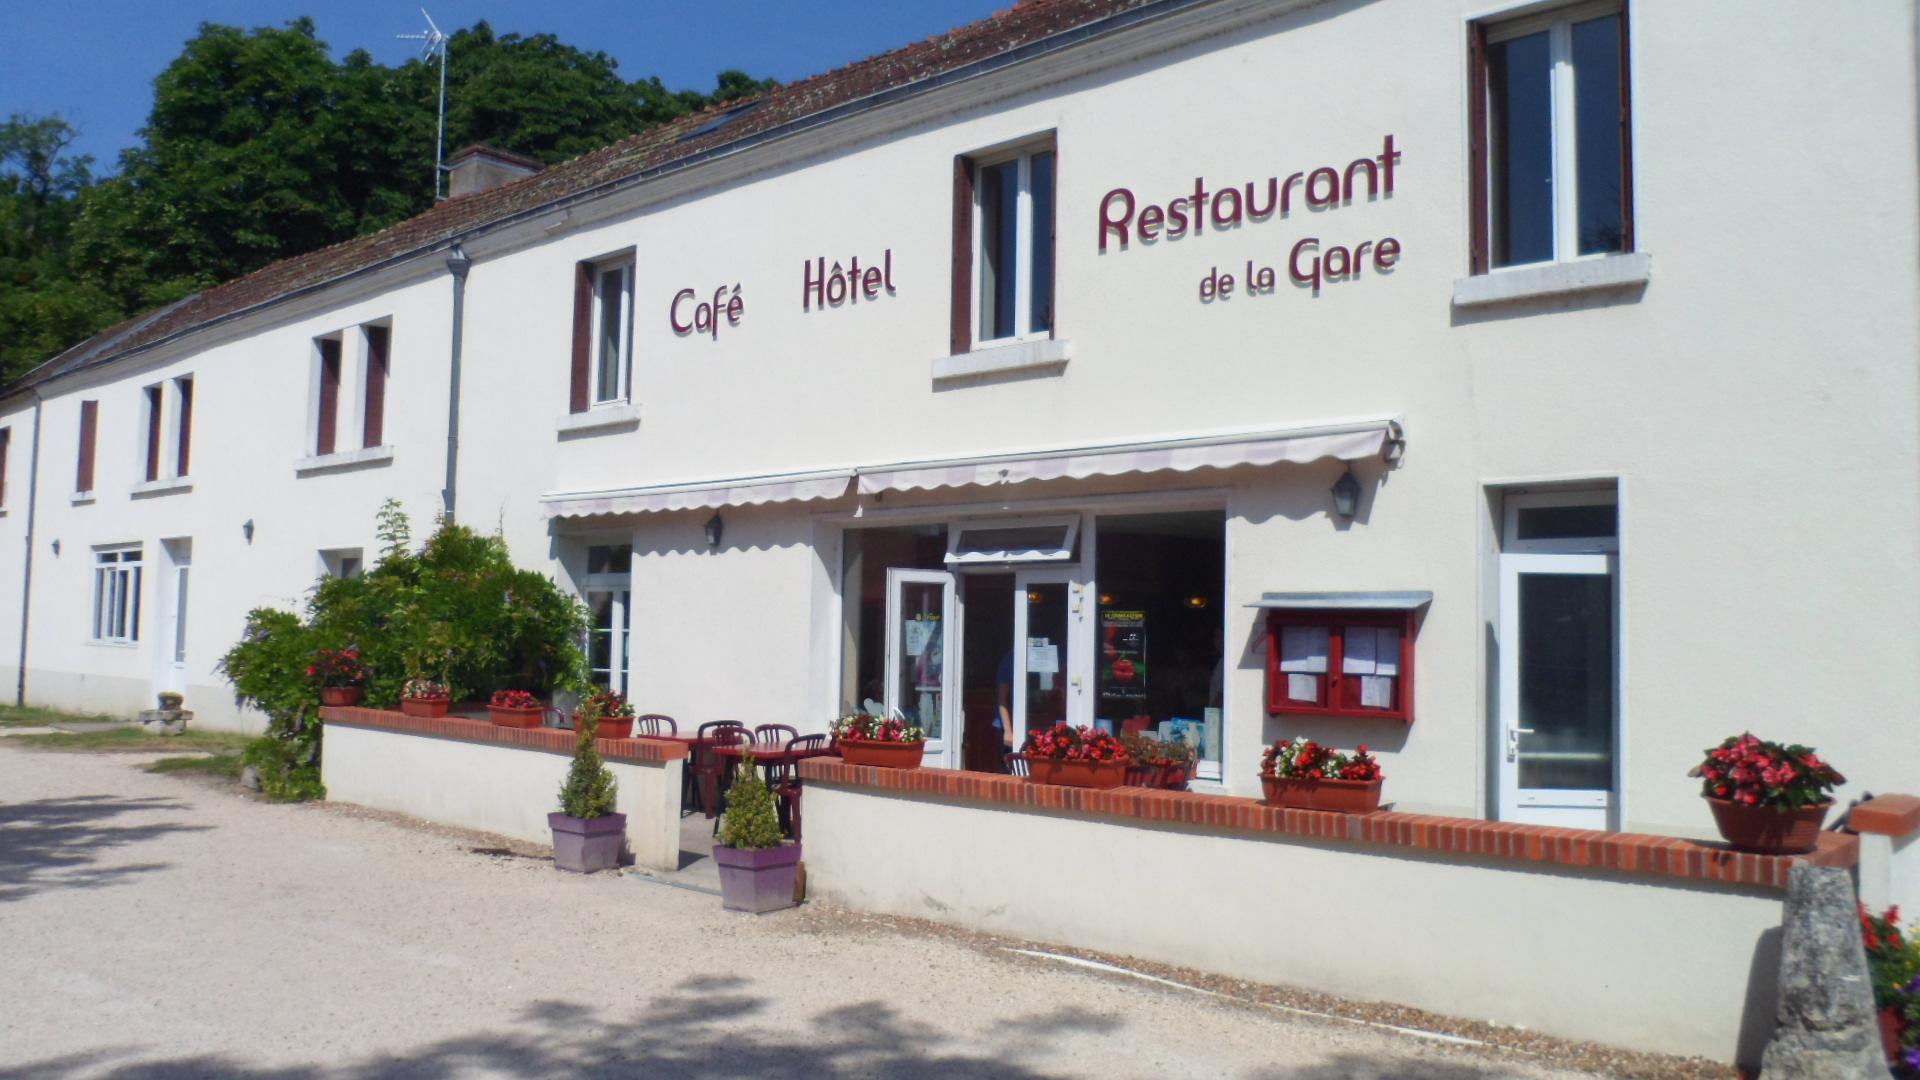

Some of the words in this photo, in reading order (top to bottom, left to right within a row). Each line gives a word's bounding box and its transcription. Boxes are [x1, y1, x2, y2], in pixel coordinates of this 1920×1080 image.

[1098, 134, 1402, 251] Restaurant
[670, 282, 744, 338] Café
[803, 249, 896, 309] Hôtel
[1199, 266, 1235, 299] de
[1246, 260, 1276, 293] la
[1288, 237, 1402, 292] Gare
